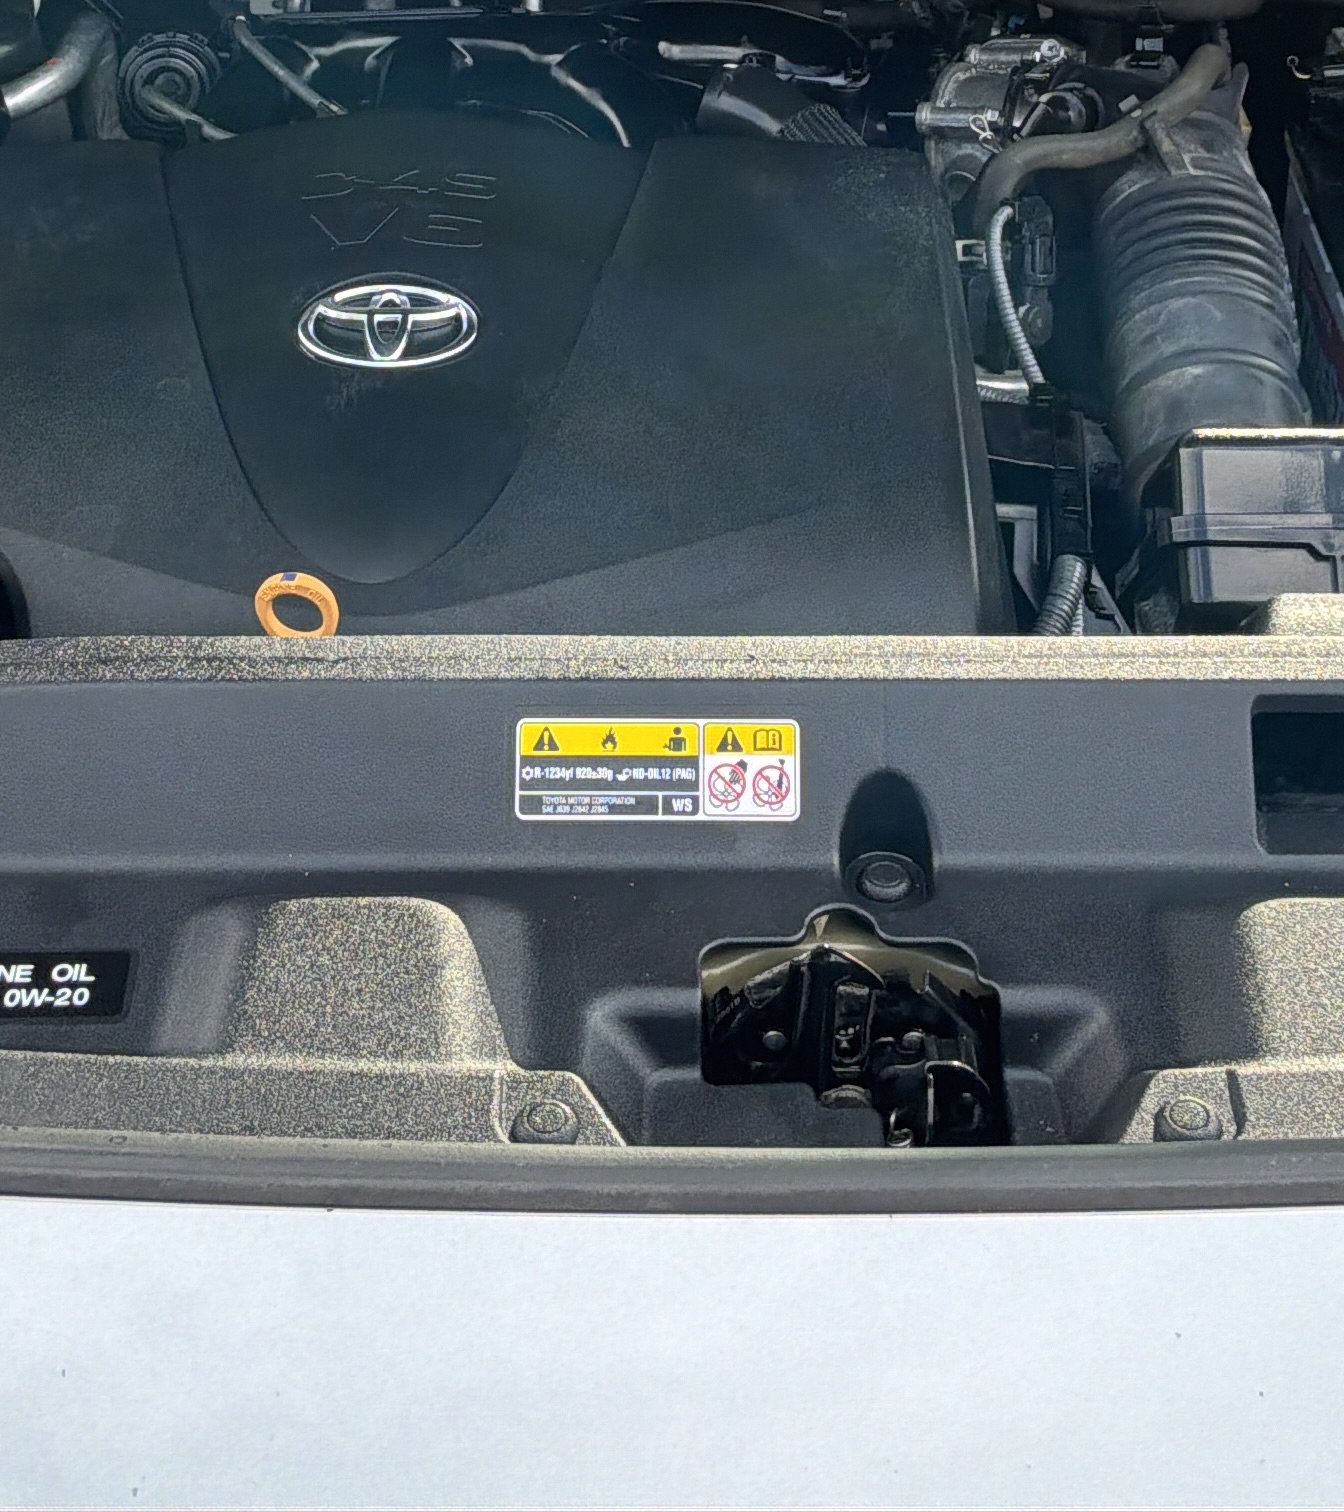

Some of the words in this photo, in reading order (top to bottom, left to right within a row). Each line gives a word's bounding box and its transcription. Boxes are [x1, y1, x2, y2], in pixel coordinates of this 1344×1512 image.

[672, 767, 696, 781] (PAG)
[542, 796, 567, 805] TOYOTA
[567, 796, 591, 805] MOTOR
[591, 796, 636, 805] CORPORATION
[672, 798, 693, 813] WS
[541, 805, 554, 814] SAE
[50, 963, 96, 983] OIL
[2, 987, 90, 1009] 0W-20
